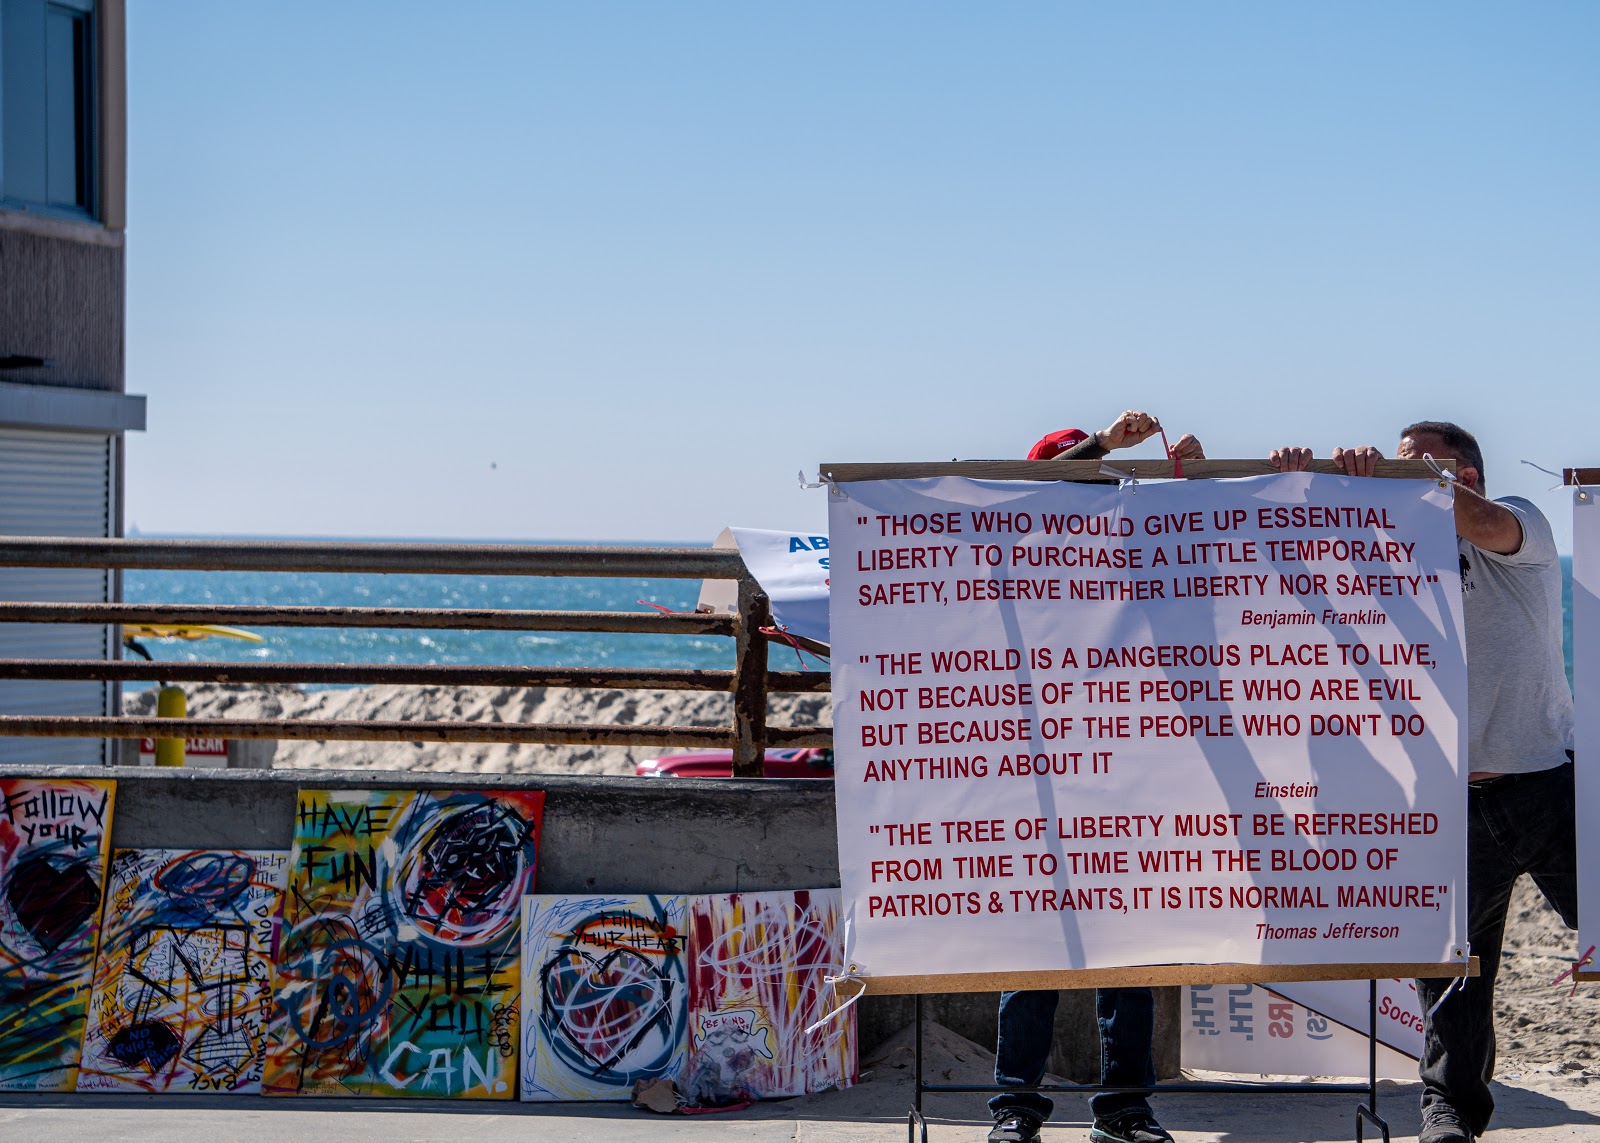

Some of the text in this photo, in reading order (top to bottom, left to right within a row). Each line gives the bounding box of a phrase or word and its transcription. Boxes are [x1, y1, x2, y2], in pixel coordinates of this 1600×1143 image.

[877, 512, 960, 535] THOSE
[972, 512, 1032, 533] WHO
[1043, 514, 1134, 537] WOULD
[1145, 512, 1203, 535] GIVE
[1214, 510, 1247, 530] UP
[1258, 507, 1395, 529] ESSENTIAL
[858, 540, 1415, 571] LIBERTY TO PURCHASE A LITTLE TEMPORARY
[858, 581, 948, 606] SAFETY,
[956, 579, 1061, 602] DESERVE
[1069, 579, 1164, 601] NEITHER
[1174, 575, 1269, 598] LIBERTY
[1279, 574, 1328, 595] NOR
[1241, 609, 1387, 629] Benjamin Franklin
[875, 653, 922, 675] THE
[931, 649, 1021, 673] WORLD
[1031, 647, 1053, 669] IS
[1061, 647, 1079, 669] A
[1087, 644, 1242, 668] DANGEROUS
[1250, 644, 1329, 667] PLACE
[1337, 644, 1370, 666] TO
[1378, 644, 1438, 669] LIVE,
[860, 679, 1422, 712] NOT BECAUSE OF THE PEOPLE WHO ARE EVIL
[861, 713, 1425, 748] BUT BECAUSE OF THE PEOPLE WHO DON'T DO
[863, 752, 1114, 783] ANYTHING ABOUT IT
[1255, 782, 1319, 799] Einstein
[298, 798, 399, 837] HAVE
[941, 819, 1006, 844] TREE
[1014, 818, 1047, 841] OF
[1057, 815, 1165, 840] LIBERTY
[1174, 813, 1243, 837] MUST
[1253, 813, 1285, 837] BE
[1293, 812, 1439, 837] REFRESHED
[255, 853, 287, 870] HELP
[257, 869, 278, 885] THE
[301, 845, 377, 895] FUN
[871, 847, 1399, 883] FROM TIME TO TIME WITH THE BLOOD OF
[868, 891, 981, 918] PATRIOTS
[987, 890, 1004, 914] &
[1009, 887, 1128, 915] TYRANTS,
[1133, 886, 1154, 910] IT
[1160, 886, 1183, 909] IS
[1188, 886, 1224, 910] ITS
[1228, 885, 1329, 909] NORMAL
[1256, 923, 1399, 940] Thomas Jefferson
